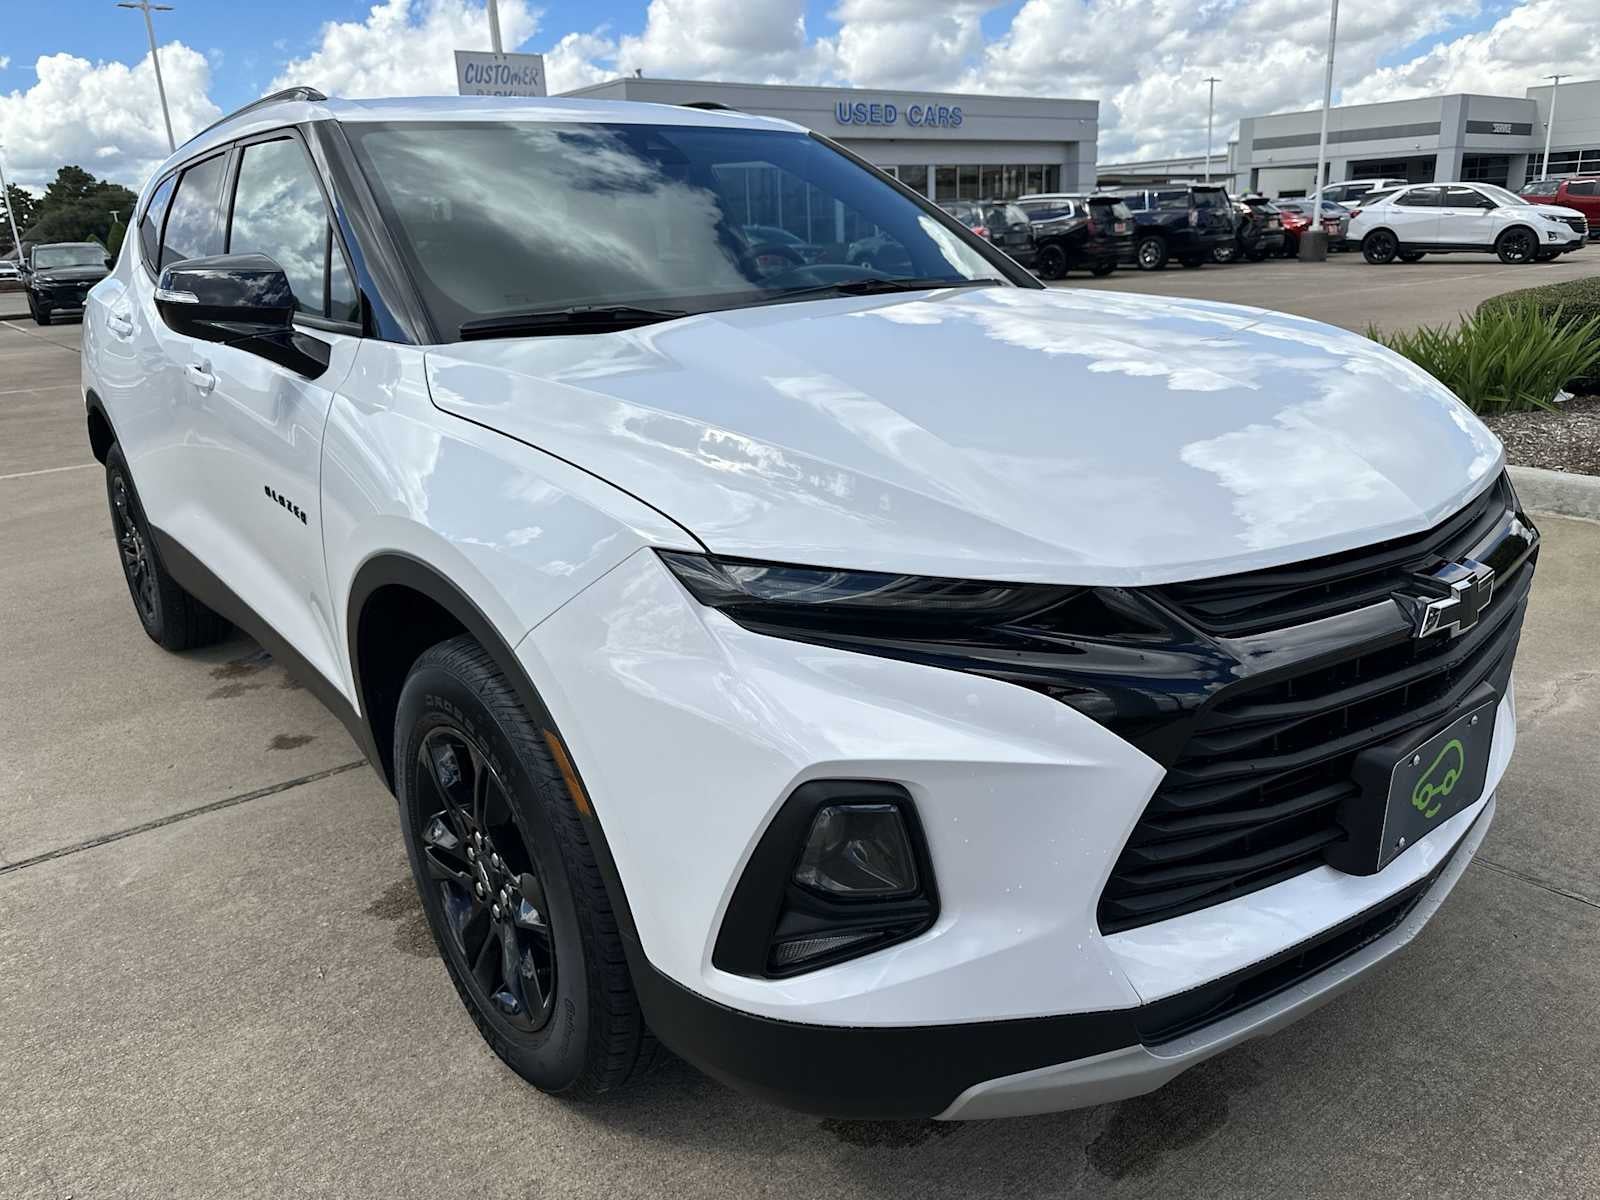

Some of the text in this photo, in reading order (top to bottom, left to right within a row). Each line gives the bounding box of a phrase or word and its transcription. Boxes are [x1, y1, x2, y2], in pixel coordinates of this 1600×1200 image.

[464, 63, 538, 85] CUSTOMER
[836, 101, 963, 128] USED CARS
